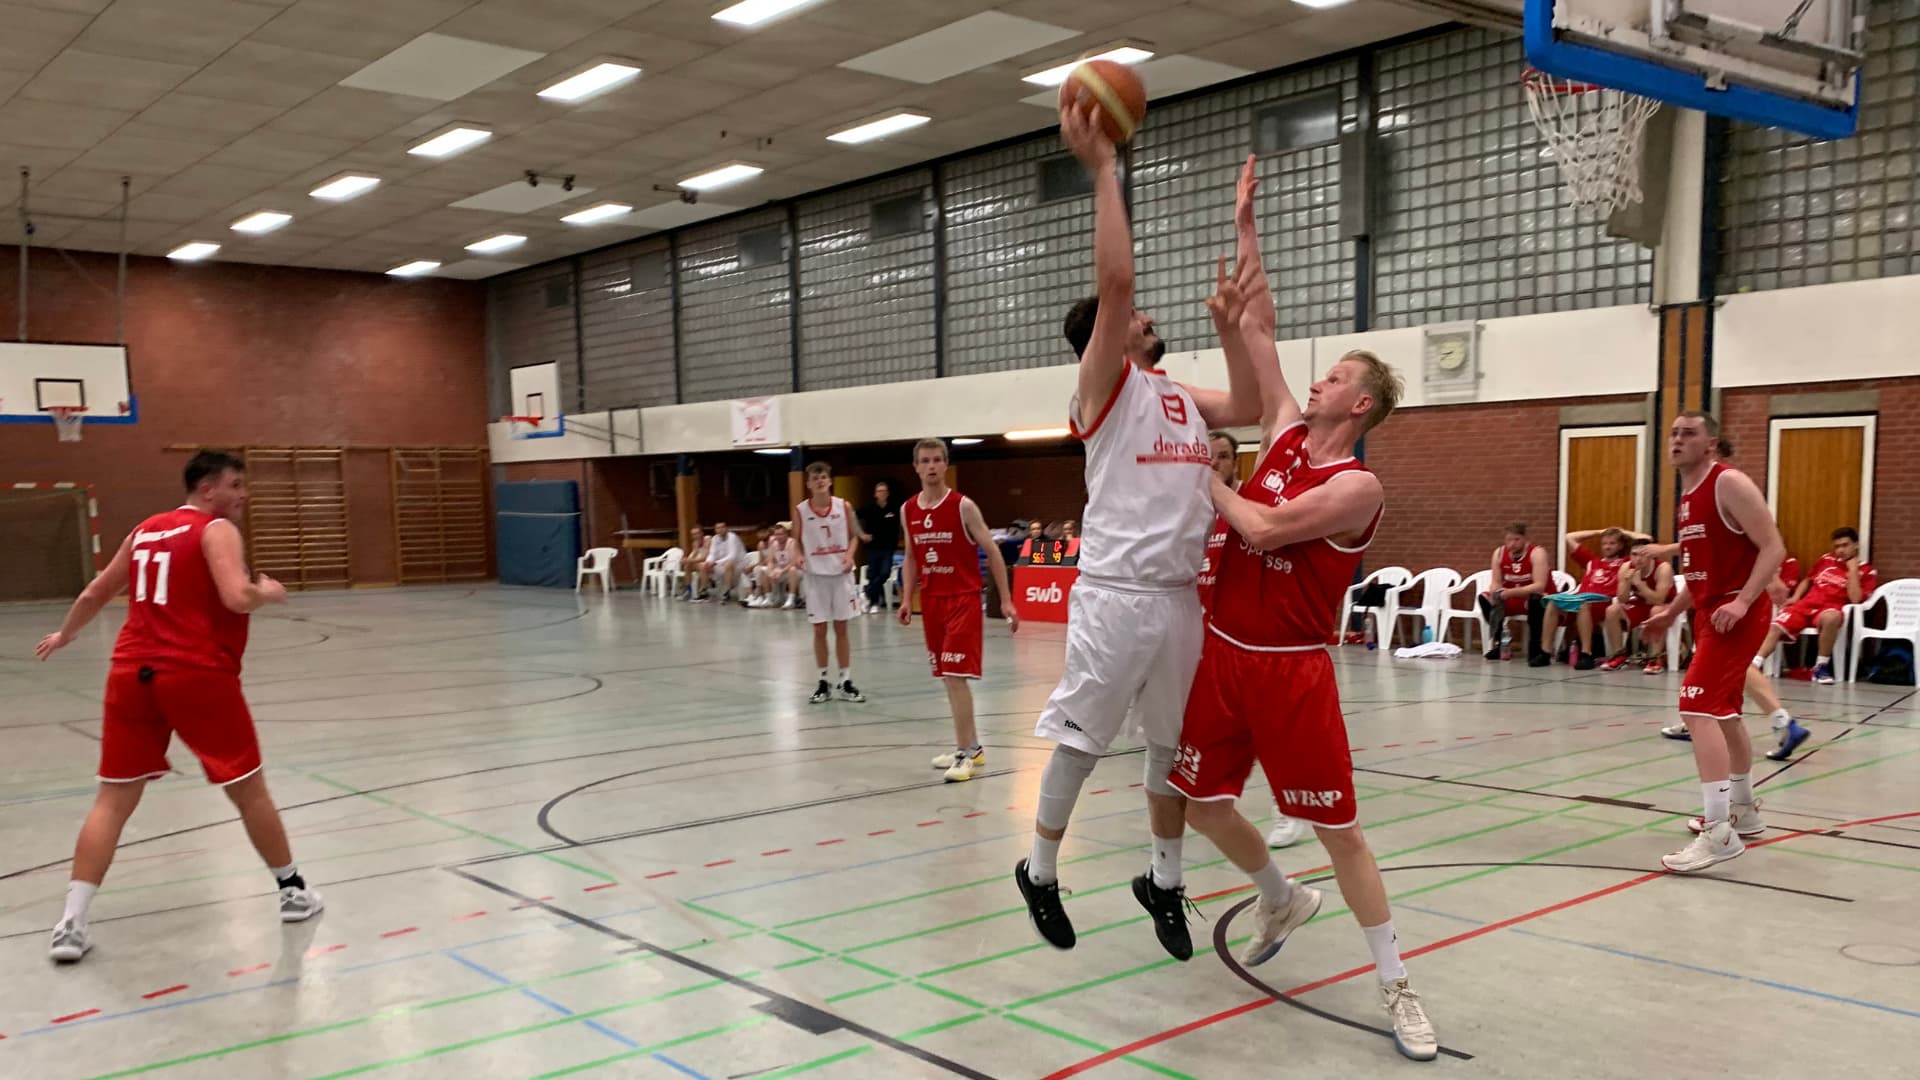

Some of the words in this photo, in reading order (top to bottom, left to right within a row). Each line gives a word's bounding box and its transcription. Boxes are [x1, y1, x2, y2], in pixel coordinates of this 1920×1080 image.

[923, 513, 933, 529] 6
[820, 525, 832, 538] 7
[132, 549, 172, 606] 11
[1025, 581, 1063, 604] swb
